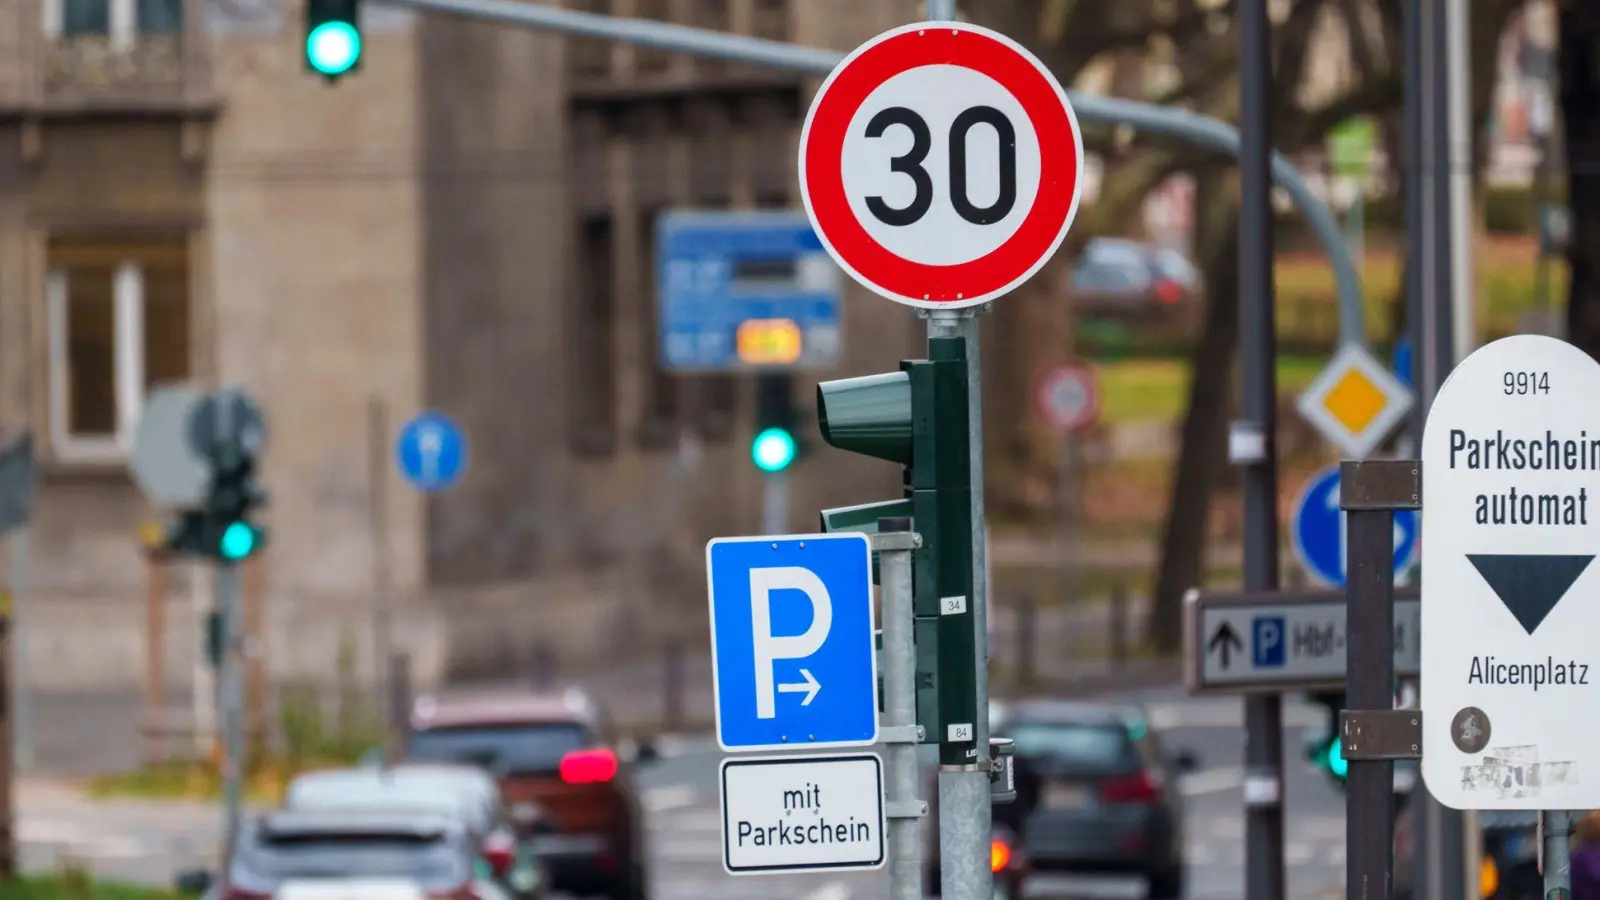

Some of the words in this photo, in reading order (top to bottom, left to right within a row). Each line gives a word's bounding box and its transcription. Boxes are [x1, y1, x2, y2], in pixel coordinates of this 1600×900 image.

[865, 105, 1017, 227] 30
[1503, 371, 1551, 396] 9914
[1449, 429, 1600, 471] Parkschein
[1475, 486, 1587, 526] automat
[948, 600, 960, 611] 34
[749, 566, 833, 720] P
[1258, 619, 1281, 667] P
[1468, 655, 1589, 692] Alicenplatz
[956, 727, 967, 738] 84
[783, 782, 821, 809] mit
[738, 816, 870, 847] Parkschein
